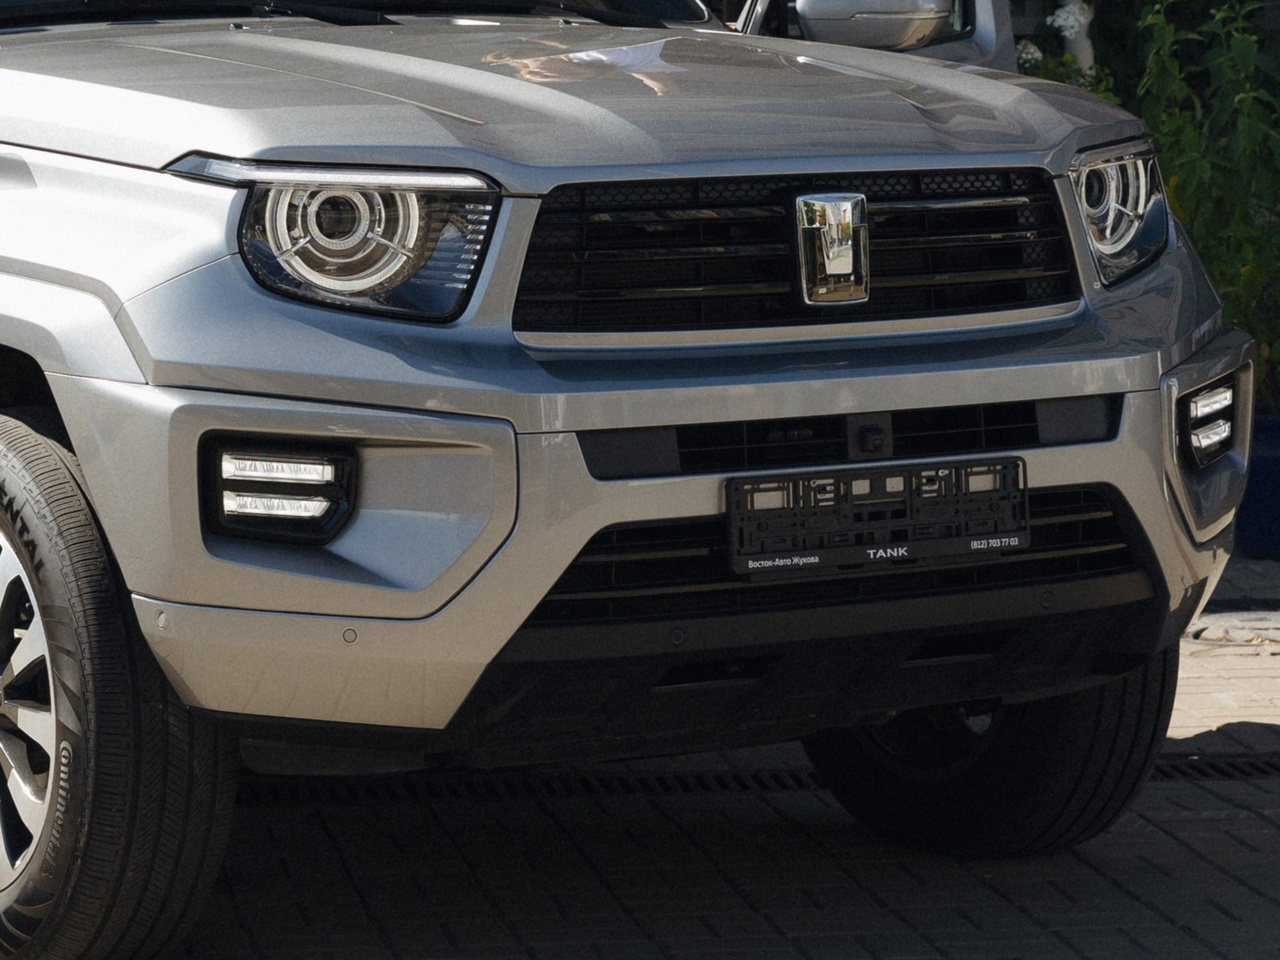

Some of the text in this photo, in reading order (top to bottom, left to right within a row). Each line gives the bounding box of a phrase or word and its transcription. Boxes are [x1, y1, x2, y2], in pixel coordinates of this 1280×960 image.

[867, 546, 908, 559] TANK
[748, 555, 819, 568] Восток-Авто Жукова
